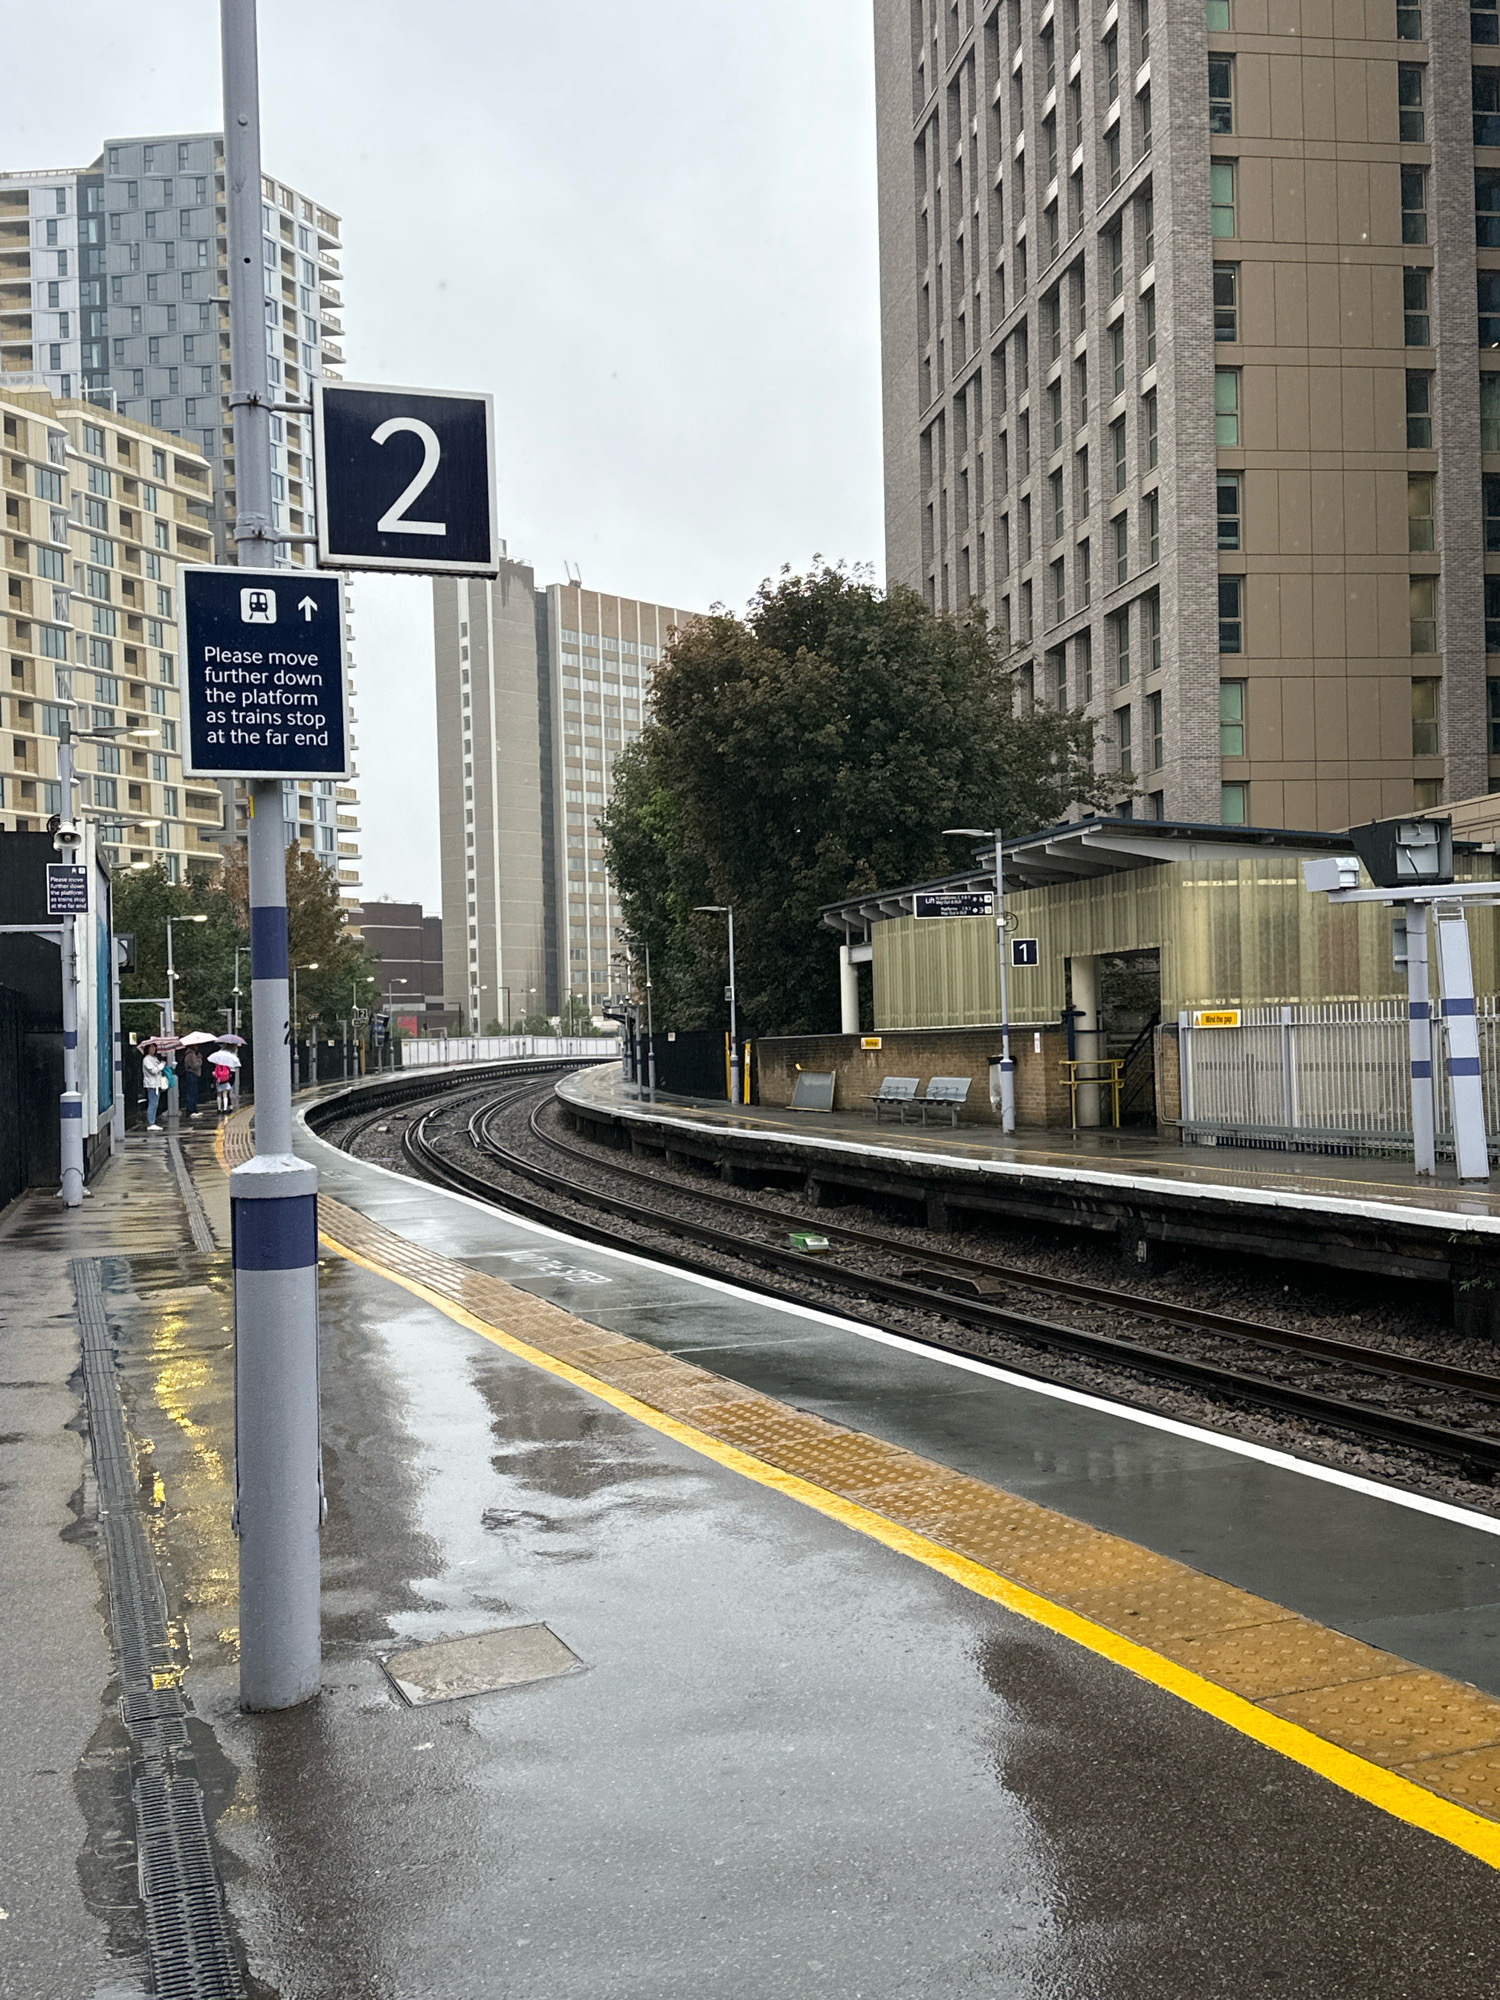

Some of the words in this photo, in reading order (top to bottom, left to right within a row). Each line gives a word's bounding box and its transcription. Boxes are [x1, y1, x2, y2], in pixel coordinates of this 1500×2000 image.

[371, 417, 446, 536] 2
[204, 646, 263, 664] Please
[268, 652, 318, 666] move
[204, 667, 269, 684] further
[273, 670, 322, 686] down
[205, 687, 236, 703] the
[241, 689, 318, 707] platform
[206, 710, 226, 723] as
[231, 709, 281, 725] trains
[286, 711, 326, 729] stop
[207, 729, 226, 744] at
[230, 729, 260, 744] the
[265, 729, 290, 745] far
[294, 731, 328, 746] end
[925, 897, 936, 905] Lift
[1018, 943, 1027, 962] 1
[1216, 1015, 1224, 1023] the
[1223, 1016, 1232, 1024] gap
[549, 1268, 613, 1284] STEP
